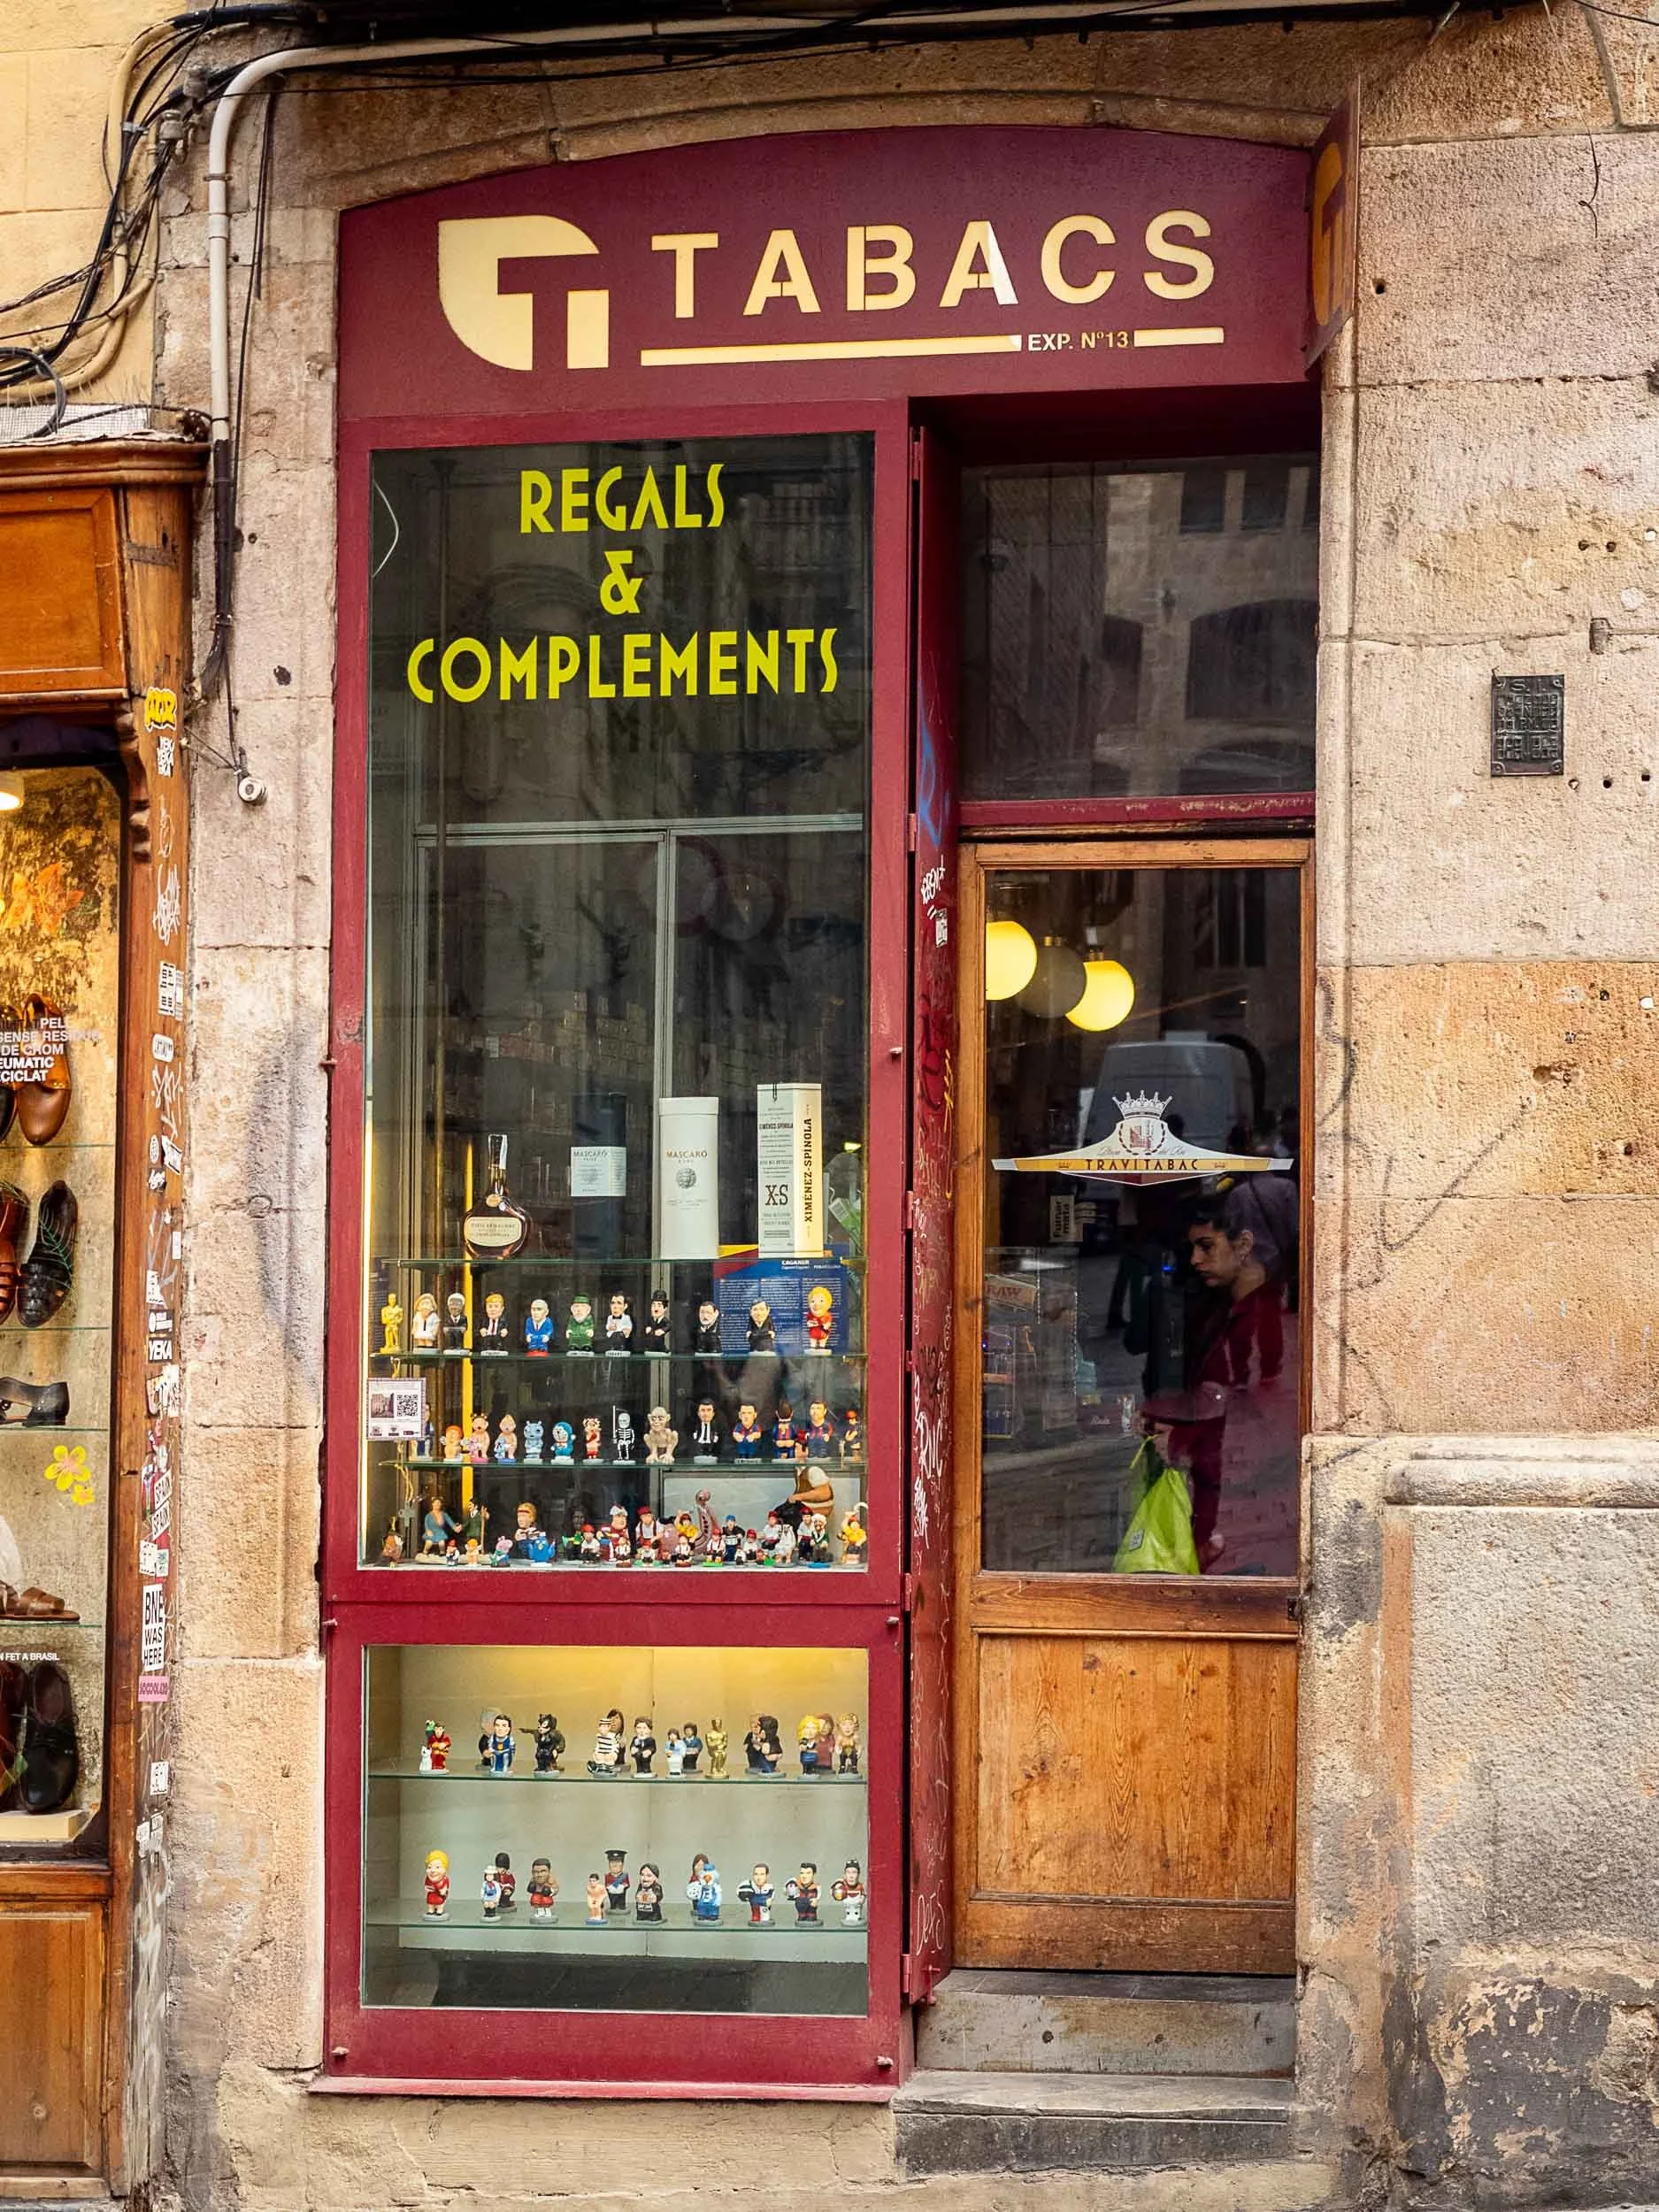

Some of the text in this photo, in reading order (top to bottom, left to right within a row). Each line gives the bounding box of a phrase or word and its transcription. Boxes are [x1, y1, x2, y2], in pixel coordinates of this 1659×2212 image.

[651, 210, 1215, 319] TABACS
[1028, 333, 1074, 351] EXP.
[520, 463, 725, 533] REGALS
[599, 550, 643, 615] &
[407, 628, 838, 703] COMPLEMENTS
[1, 1045, 19, 1056] DE
[0, 1070, 48, 1082] CICLAT
[1086, 1159, 1199, 1170] TRAVITABAC
[149, 1340, 173, 1361] YEKA
[145, 1627, 162, 1646] WAS
[5, 1652, 21, 1661] FET
[22, 1652, 29, 1661] A
[30, 1652, 60, 1661] BRASIL
[143, 1647, 162, 1665] HERE
